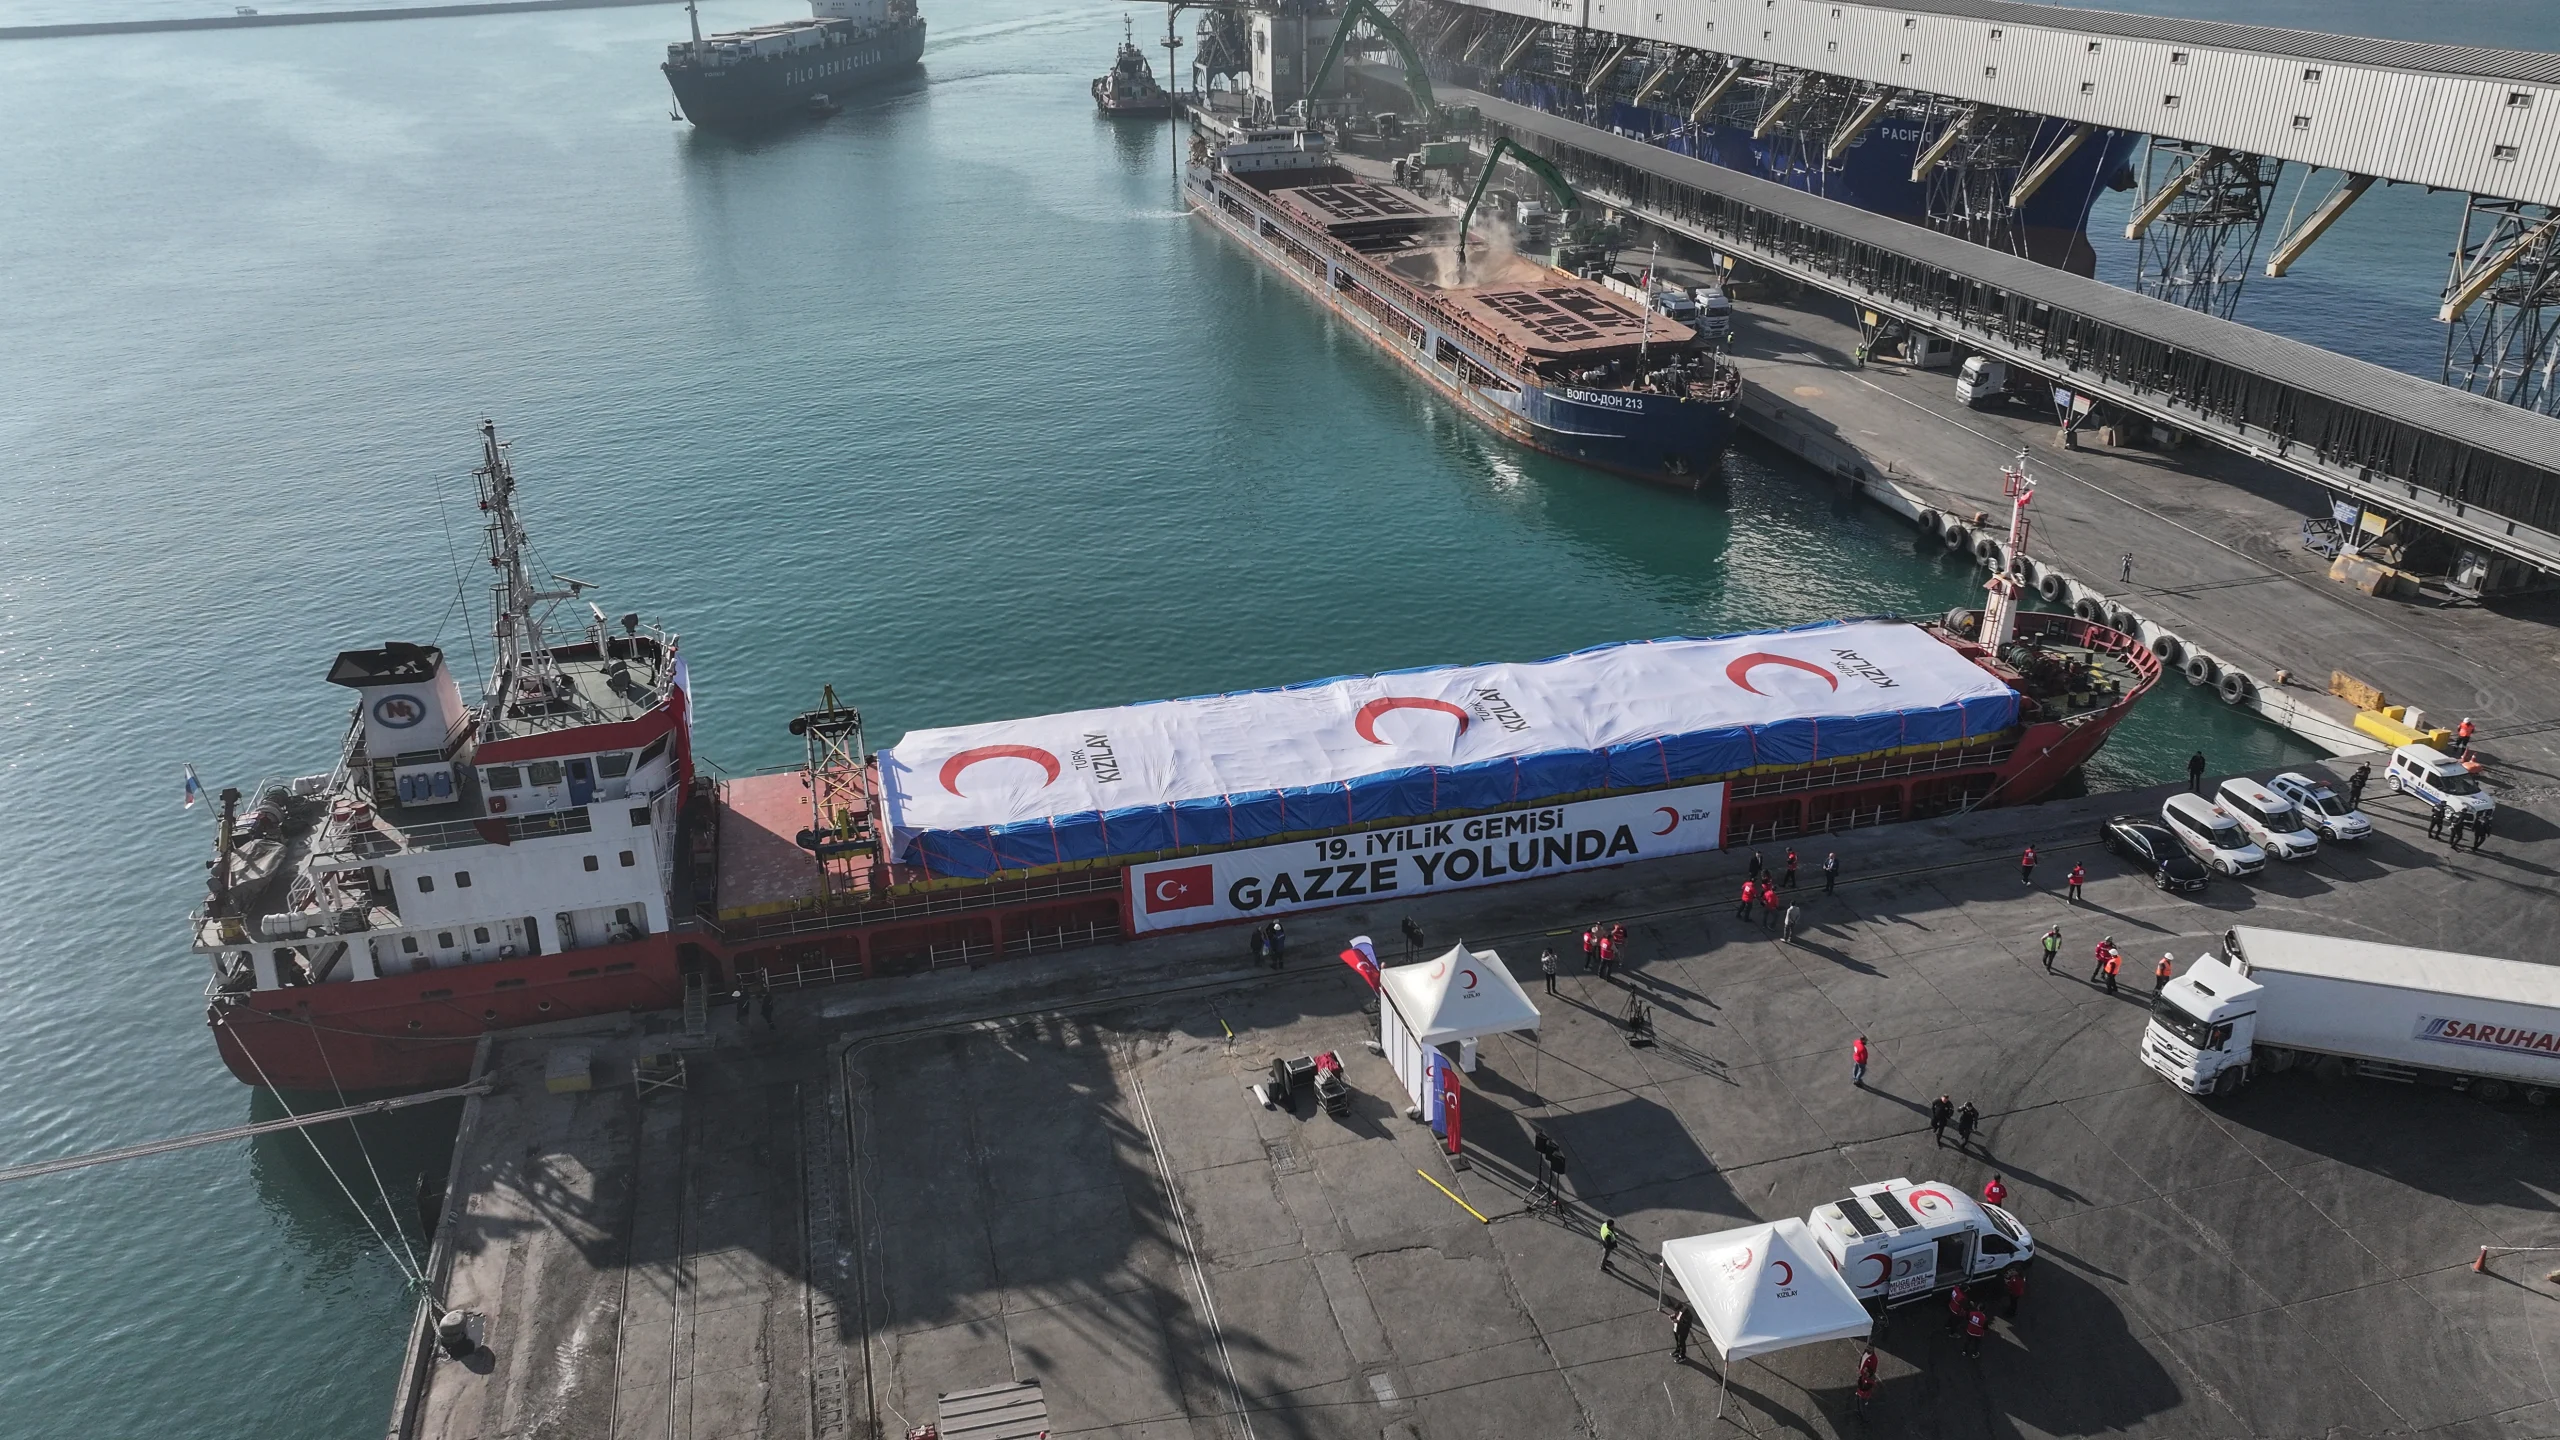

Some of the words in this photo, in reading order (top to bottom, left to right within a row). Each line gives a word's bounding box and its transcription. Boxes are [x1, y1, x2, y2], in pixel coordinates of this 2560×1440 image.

[786, 67, 813, 87] FİLO
[1882, 127, 1932, 143] PACIFC
[1566, 388, 1623, 407] ВОЛГО-ДОН
[1625, 397, 1643, 409] 213
[1830, 648, 1900, 689] KIZILAY
[1475, 688, 1532, 733] KIZILAY
[1070, 748, 1089, 771] TÜRK
[1083, 733, 1122, 784] KIZILAY
[1682, 811, 1711, 822] KIZILAY
[1315, 838, 1356, 862] 19.
[1228, 858, 1398, 911] GAZZE
[1412, 824, 1639, 886] YOLUNDA
